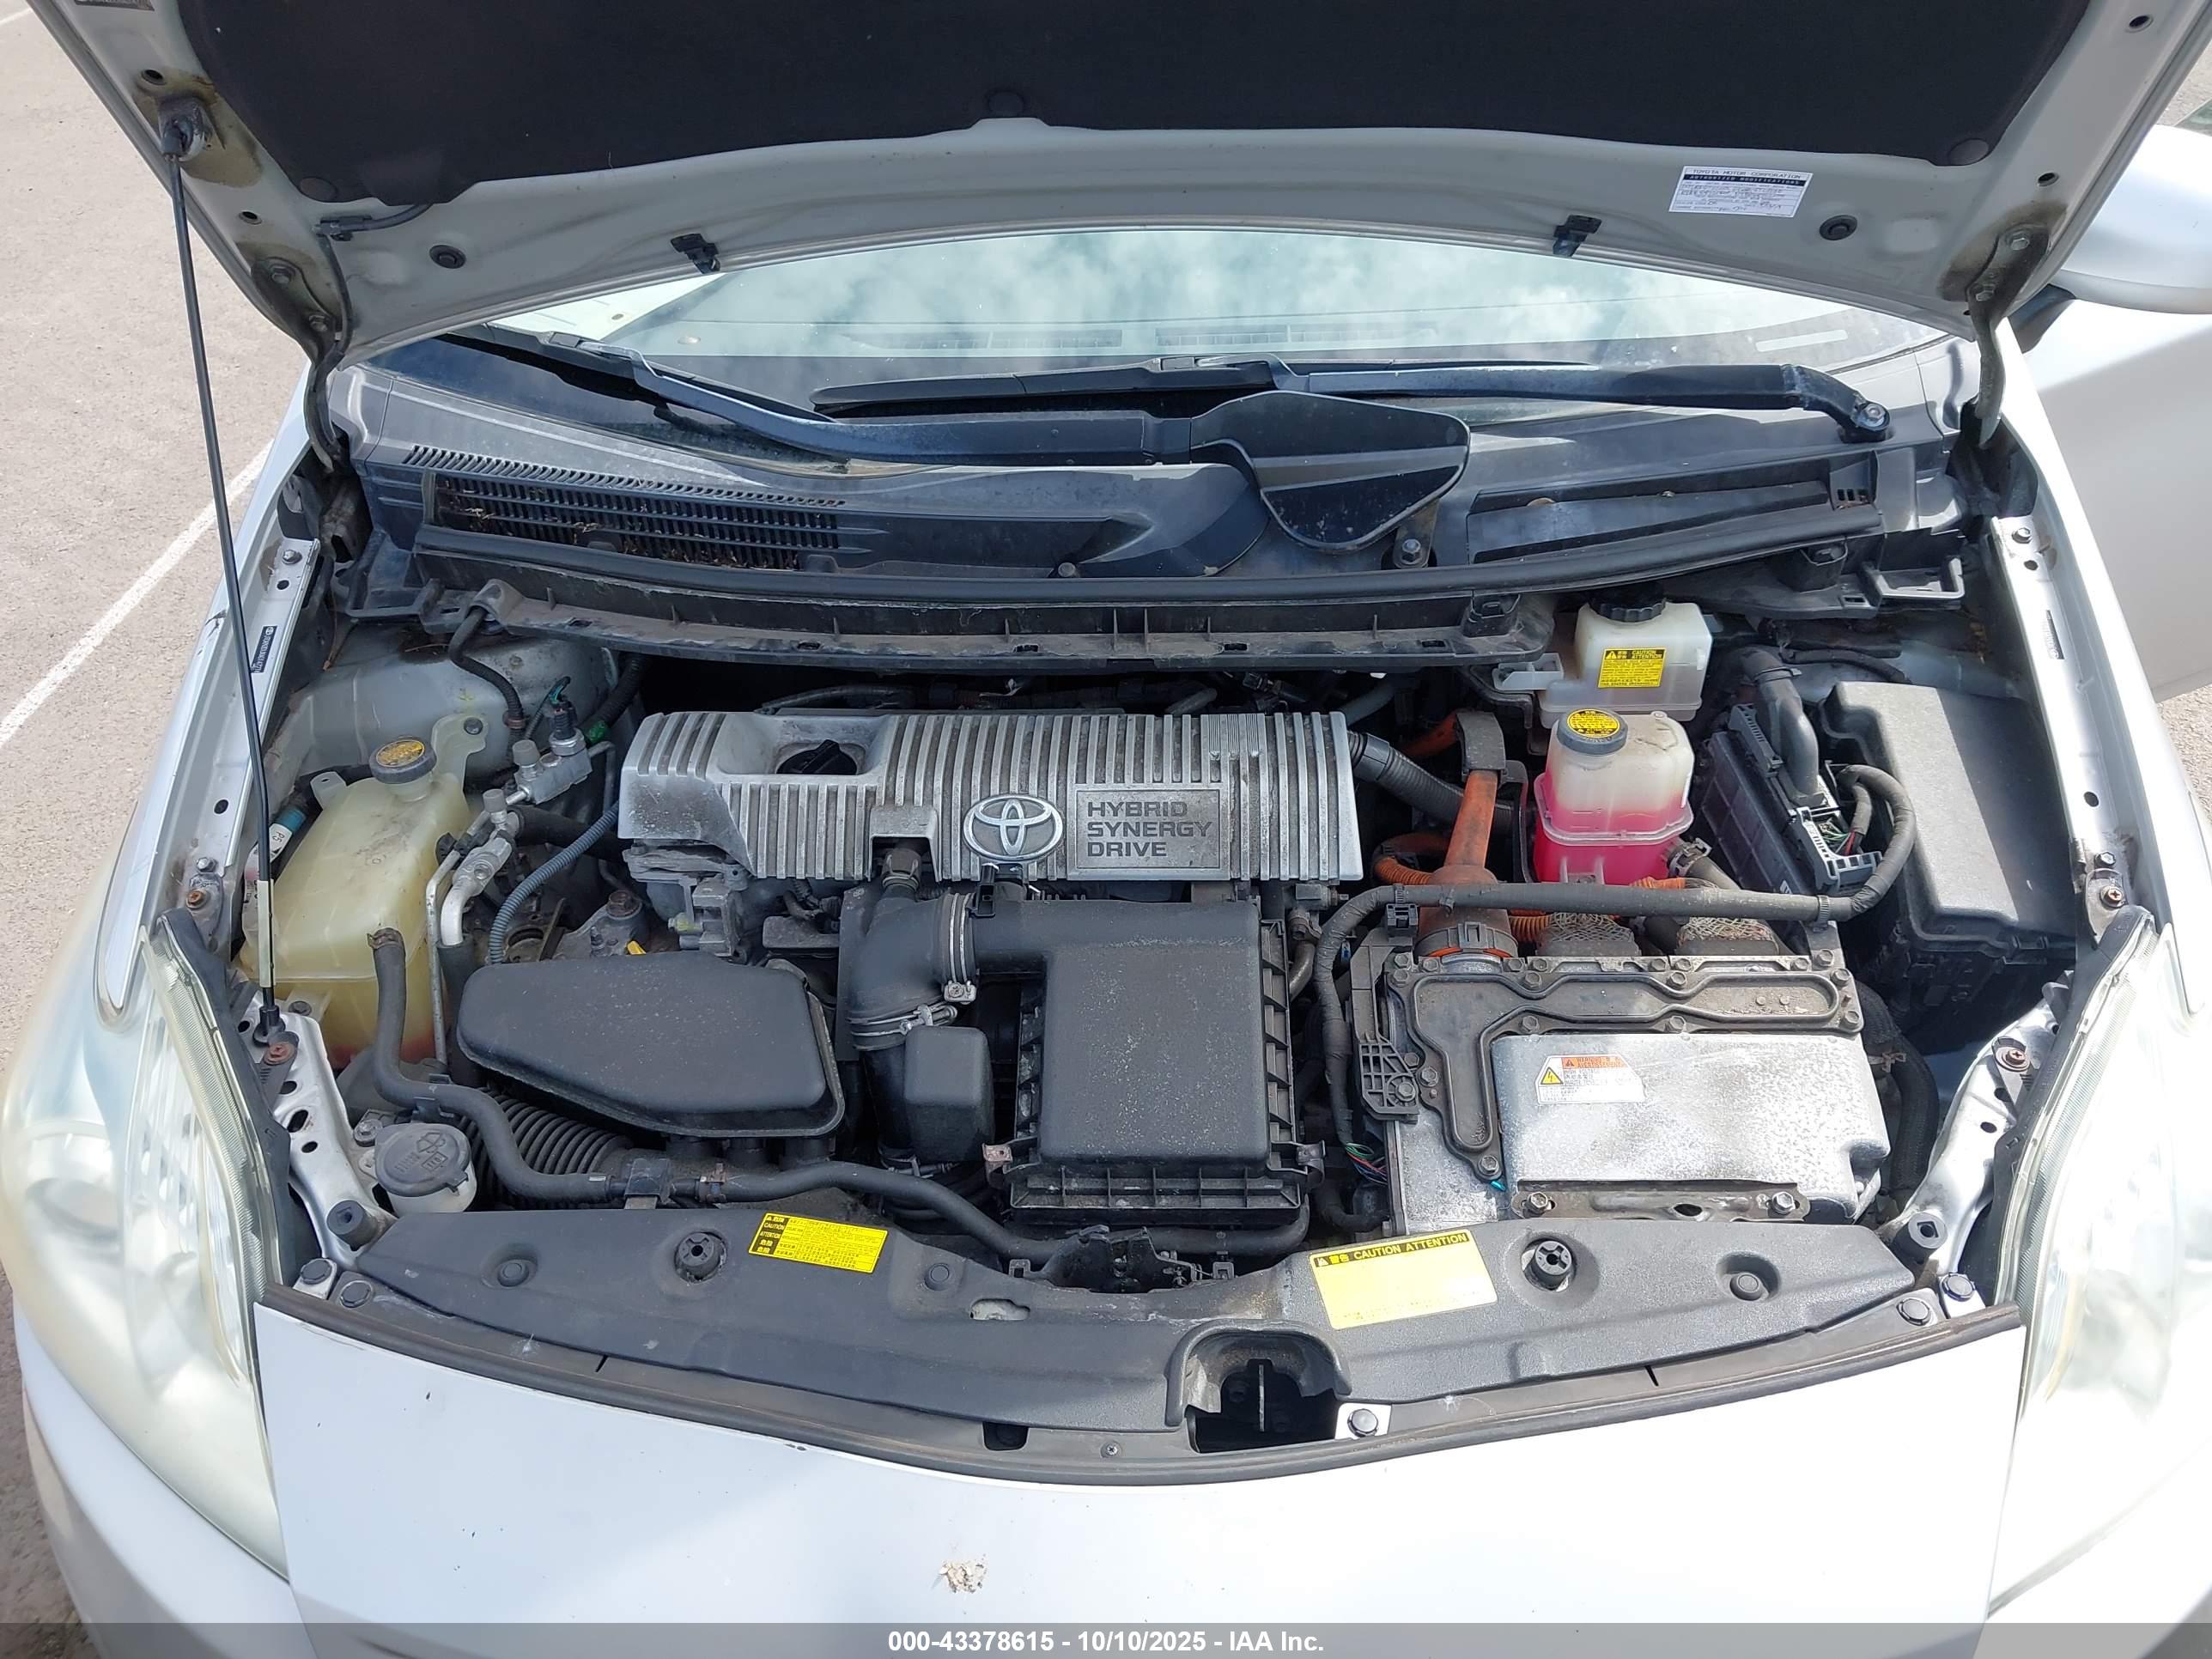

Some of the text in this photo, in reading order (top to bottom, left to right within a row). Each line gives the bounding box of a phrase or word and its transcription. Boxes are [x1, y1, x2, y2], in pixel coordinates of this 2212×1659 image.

[1087, 801, 1188, 817] HYBRID
[1087, 821, 1213, 837] SYNERGY
[1087, 842, 1168, 857] DRIVE
[1353, 1245, 1401, 1260] CAUTION
[1406, 1234, 1468, 1251] ATTENTION
